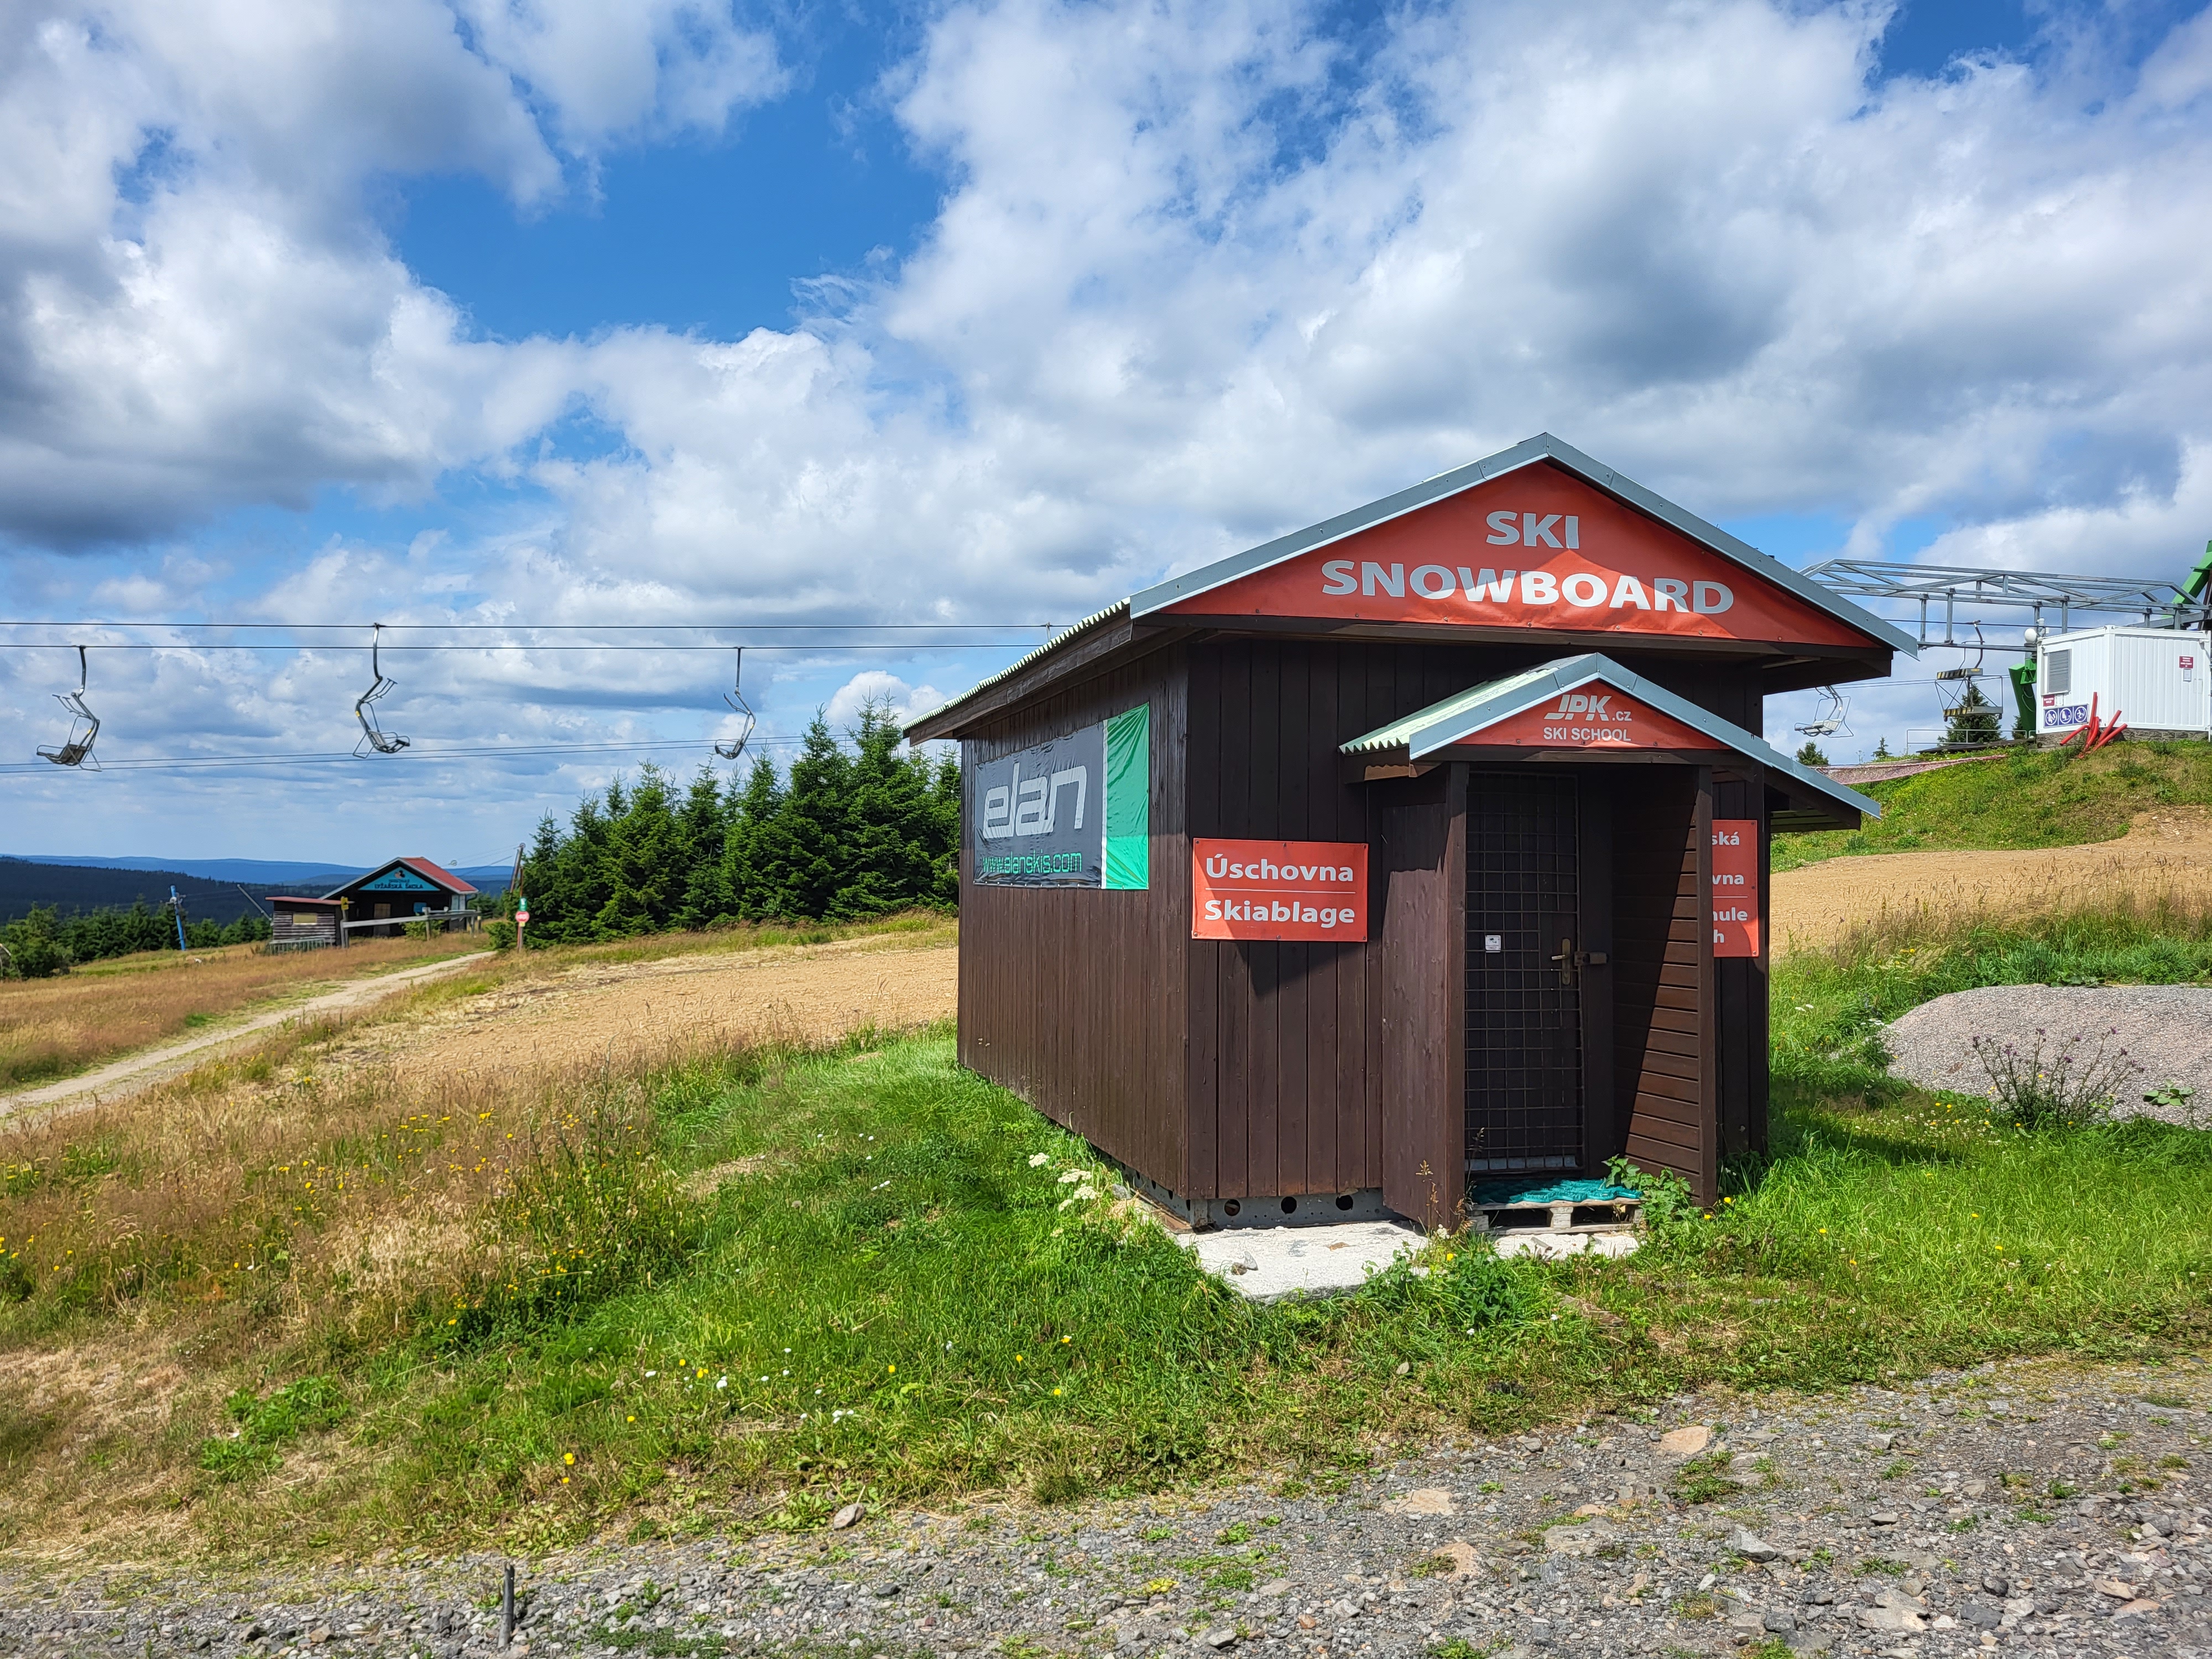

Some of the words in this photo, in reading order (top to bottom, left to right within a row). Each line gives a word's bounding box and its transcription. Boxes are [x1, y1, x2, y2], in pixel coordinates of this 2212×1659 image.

[1486, 510, 1579, 549] SKI
[1322, 560, 1734, 614] SNOWBOARD
[1543, 727, 1567, 740] SKI
[1571, 728, 1631, 741] SCHOOL
[983, 762, 1087, 839] elan
[983, 849, 1082, 874] www.elanskis.com
[1206, 853, 1353, 881] Úschovna
[1204, 900, 1355, 928] Skiablage
